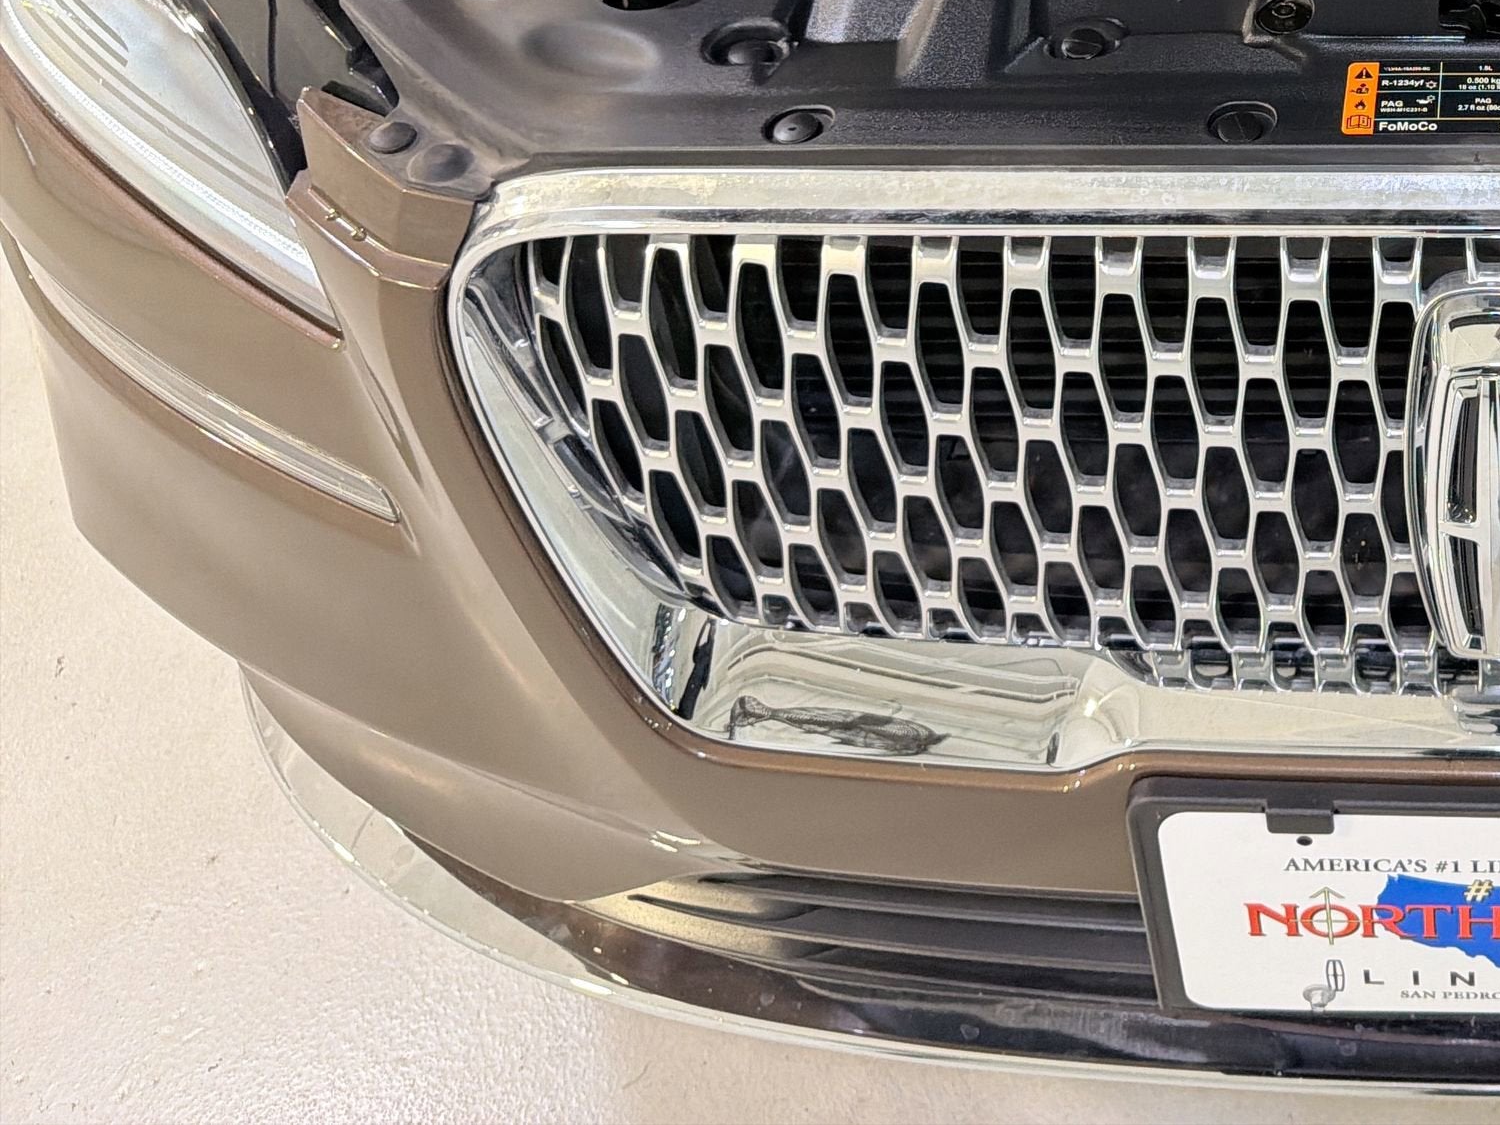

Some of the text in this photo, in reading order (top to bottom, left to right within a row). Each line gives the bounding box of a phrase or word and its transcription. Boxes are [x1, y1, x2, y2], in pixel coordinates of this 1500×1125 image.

[1381, 79, 1425, 88] R-1234yf
[1378, 121, 1438, 131] FoMoCo
[1283, 857, 1427, 873] AMERICA'S
[1435, 859, 1462, 873] #1
[1400, 990, 1436, 999] SAN
